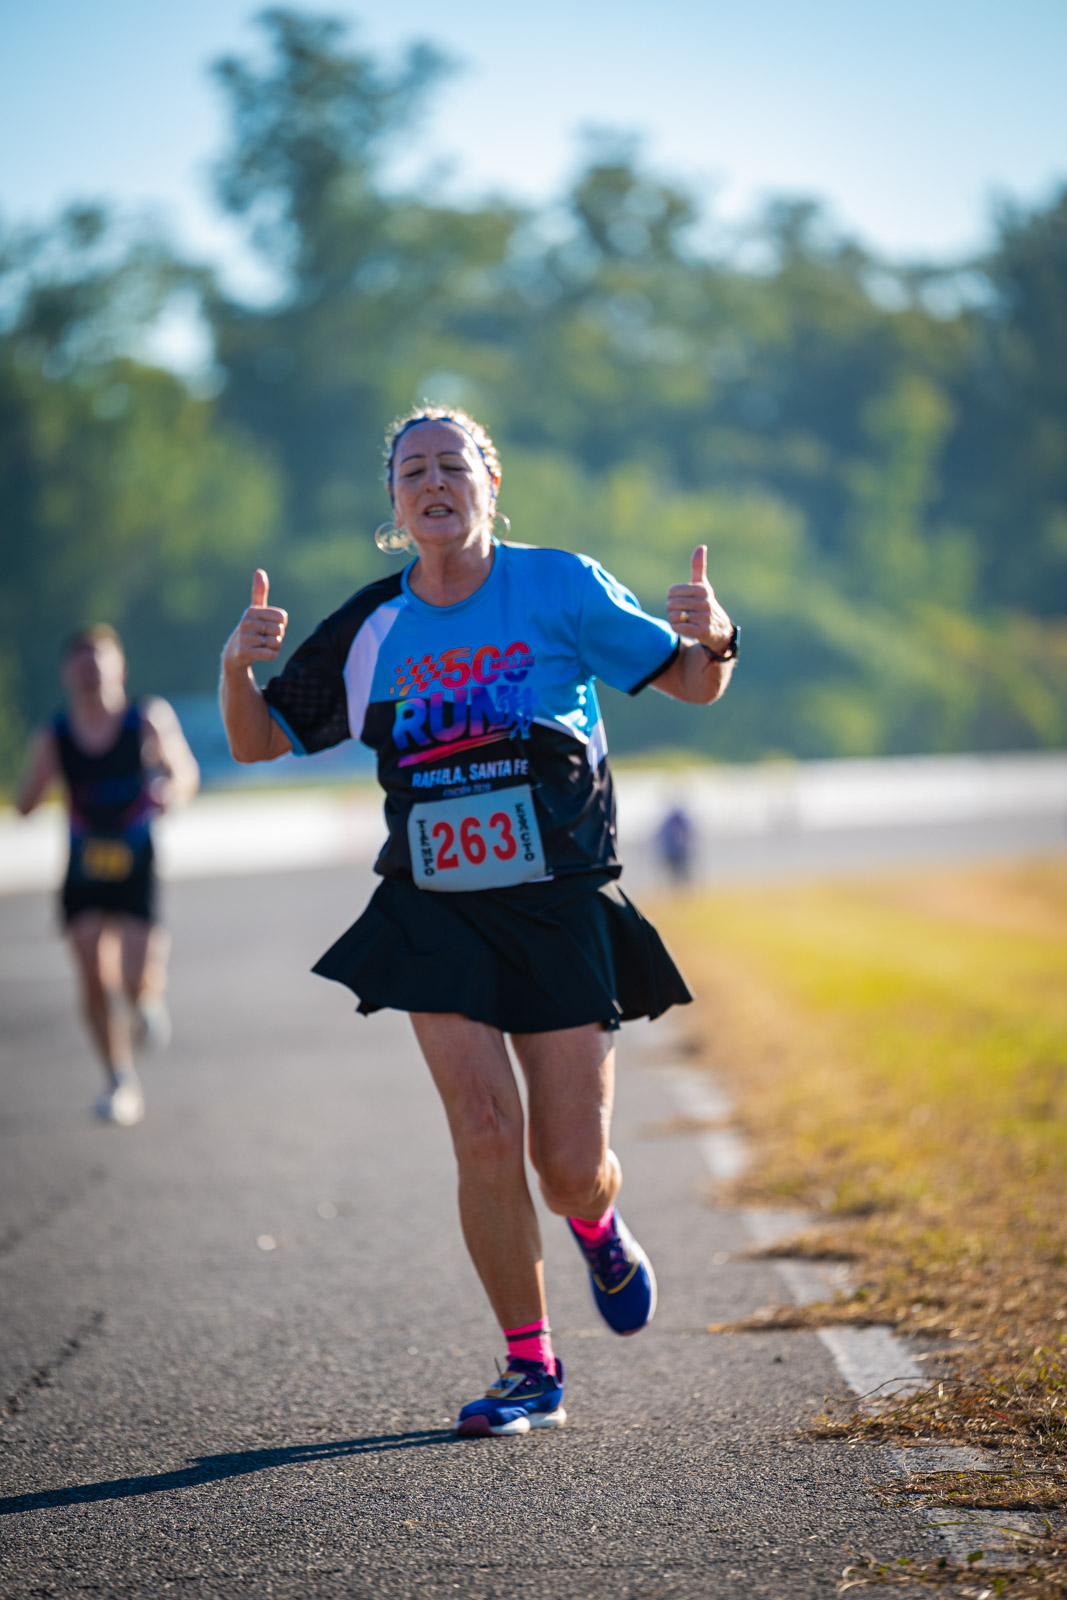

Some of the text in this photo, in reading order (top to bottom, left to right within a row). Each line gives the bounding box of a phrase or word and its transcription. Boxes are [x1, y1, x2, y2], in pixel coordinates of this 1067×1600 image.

[440, 641, 530, 689] 500
[491, 655, 535, 671] MILLAS
[469, 759, 512, 781] SANTA
[514, 758, 529, 775] FE
[416, 819, 435, 876] TIEMPO
[431, 811, 517, 871] 263
[515, 803, 535, 861] EXACTO
